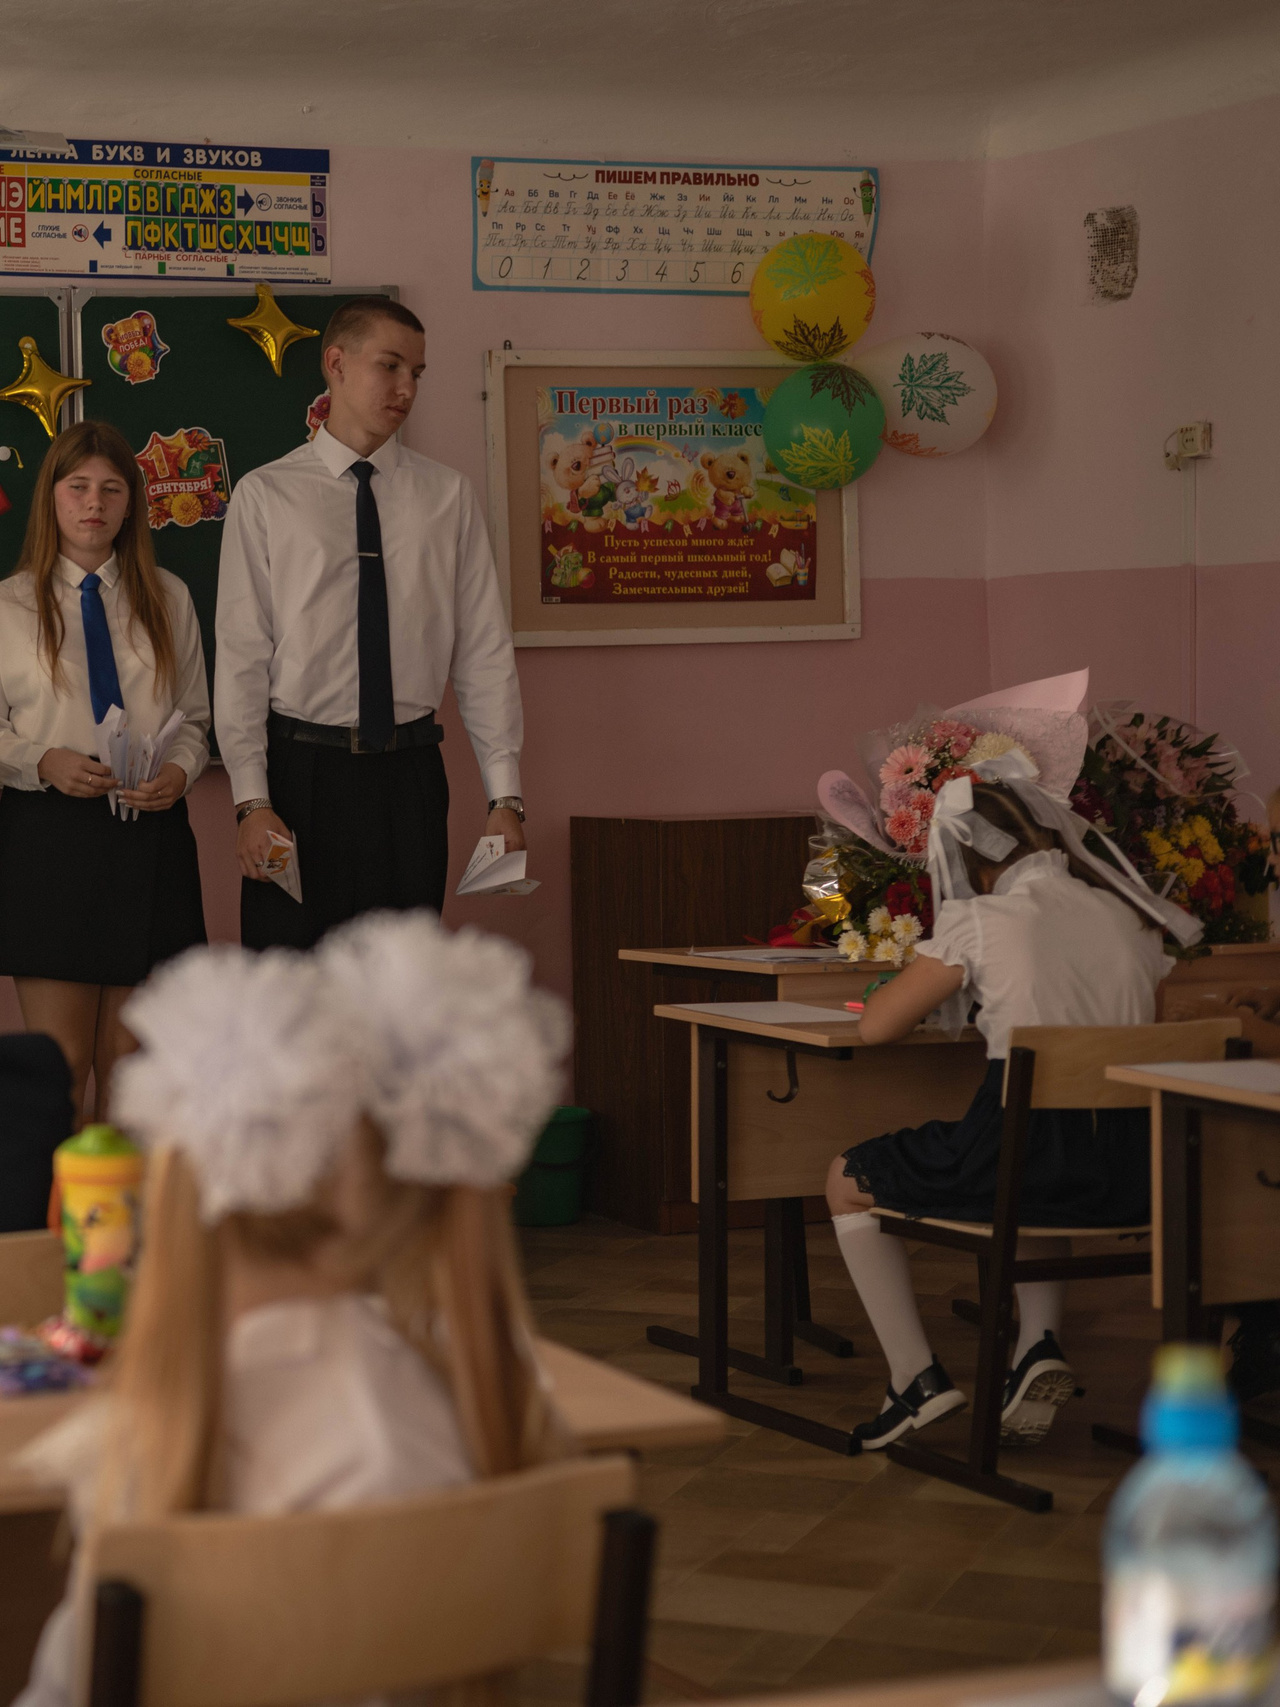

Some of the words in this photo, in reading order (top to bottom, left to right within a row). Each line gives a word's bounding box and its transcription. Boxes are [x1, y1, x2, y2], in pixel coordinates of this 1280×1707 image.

[92, 144, 144, 162] БУКВ
[157, 147, 170, 163] И
[183, 148, 262, 168] ЗВУКОВ
[134, 169, 203, 182] СОГЛАСНЫЕ
[595, 170, 656, 184] ПИШЕМ
[660, 171, 759, 187] ПРАВИЛЬНО
[504, 189, 515, 197] Аа
[528, 190, 539, 198] Бб
[549, 190, 560, 198] Вв
[569, 191, 577, 199] Гг
[587, 191, 599, 201] Дд
[608, 192, 618, 200] Ее
[625, 190, 636, 200] Ёё
[650, 192, 665, 201] Жж
[677, 194, 688, 202] Зз
[699, 194, 711, 202] Ии
[722, 193, 735, 203] Йй
[746, 195, 757, 203] Кк
[768, 195, 779, 203] Лл
[794, 196, 807, 204] Мм
[822, 197, 833, 205] Нн
[843, 197, 855, 205] Оо
[273, 203, 309, 211] СОГЛАСНЫЕ
[492, 222, 503, 230] Пп
[516, 223, 527, 232] Рр
[535, 223, 546, 231] Сс
[562, 224, 571, 232] Тт
[586, 224, 596, 235] Уу
[606, 225, 620, 234] Фф
[633, 226, 644, 234] Хх
[658, 227, 670, 236] Цц
[707, 228, 722, 236] Шш
[736, 228, 752, 237] Щщ
[135, 252, 171, 261] ПАРНЫЕ
[176, 254, 229, 263] СОГЛАСНЫЕ
[499, 256, 512, 279] 0
[543, 257, 551, 279] 1
[577, 258, 590, 280] 2
[616, 259, 628, 281] 3
[655, 260, 667, 282] 4
[689, 261, 706, 283] 5
[731, 262, 744, 284] 6
[556, 390, 659, 420] Первый
[668, 399, 709, 420] раз
[618, 423, 628, 436] в
[635, 419, 705, 440] первый
[711, 423, 763, 436] класс
[146, 443, 170, 478] 1
[148, 477, 212, 496] СЕНТЯБРЯ!
[604, 535, 639, 549] Пусть
[643, 537, 688, 550] успехов
[691, 538, 725, 548] много
[727, 536, 754, 548] ждёт
[587, 551, 596, 563] В
[600, 552, 637, 563] самый
[641, 552, 684, 564] первый
[687, 551, 747, 562] школьный
[749, 550, 772, 563] год!
[609, 567, 661, 580] Радости,
[664, 569, 719, 580] чудесных
[721, 567, 752, 580] дней,
[612, 582, 704, 595] Замечательных
[706, 581, 749, 596] друзей!
